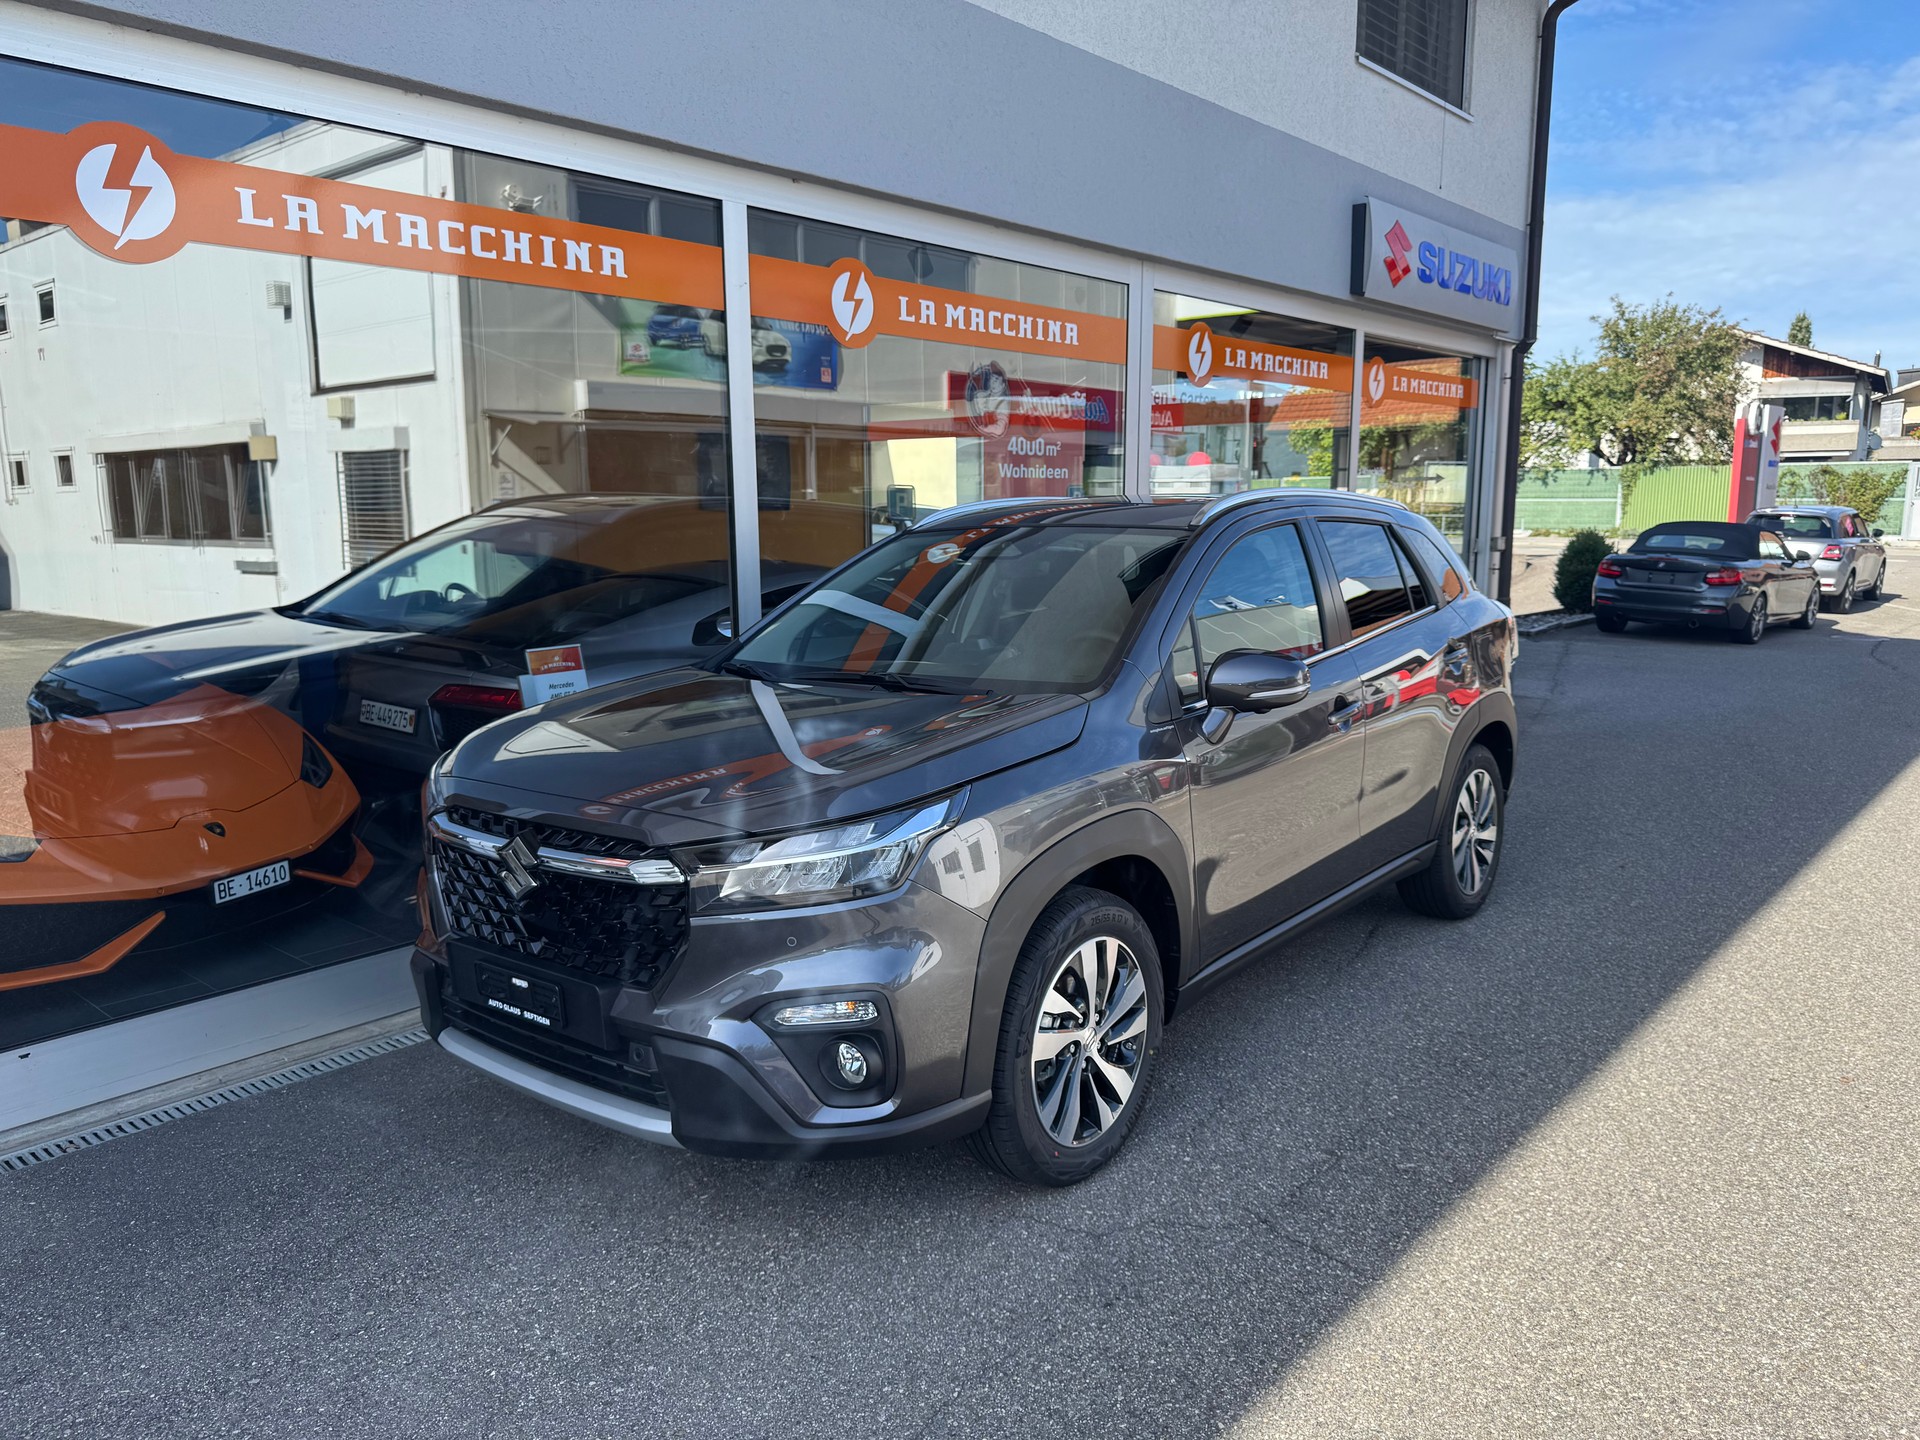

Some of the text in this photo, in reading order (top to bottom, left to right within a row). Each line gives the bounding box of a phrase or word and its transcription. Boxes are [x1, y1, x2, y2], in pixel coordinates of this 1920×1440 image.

[234, 187, 628, 278] LA MACCHINA
[1417, 241, 1512, 306] SUZUKI
[898, 296, 1079, 346] LA MACCHINA
[1224, 347, 1329, 380] LA MACCHINA
[1392, 375, 1464, 399] LA MACCHINA
[999, 463, 1069, 479] Wohnideen
[549, 682, 574, 690] Mercedes
[488, 998, 550, 1025] AUTO GLAUS SEFTIGEN
